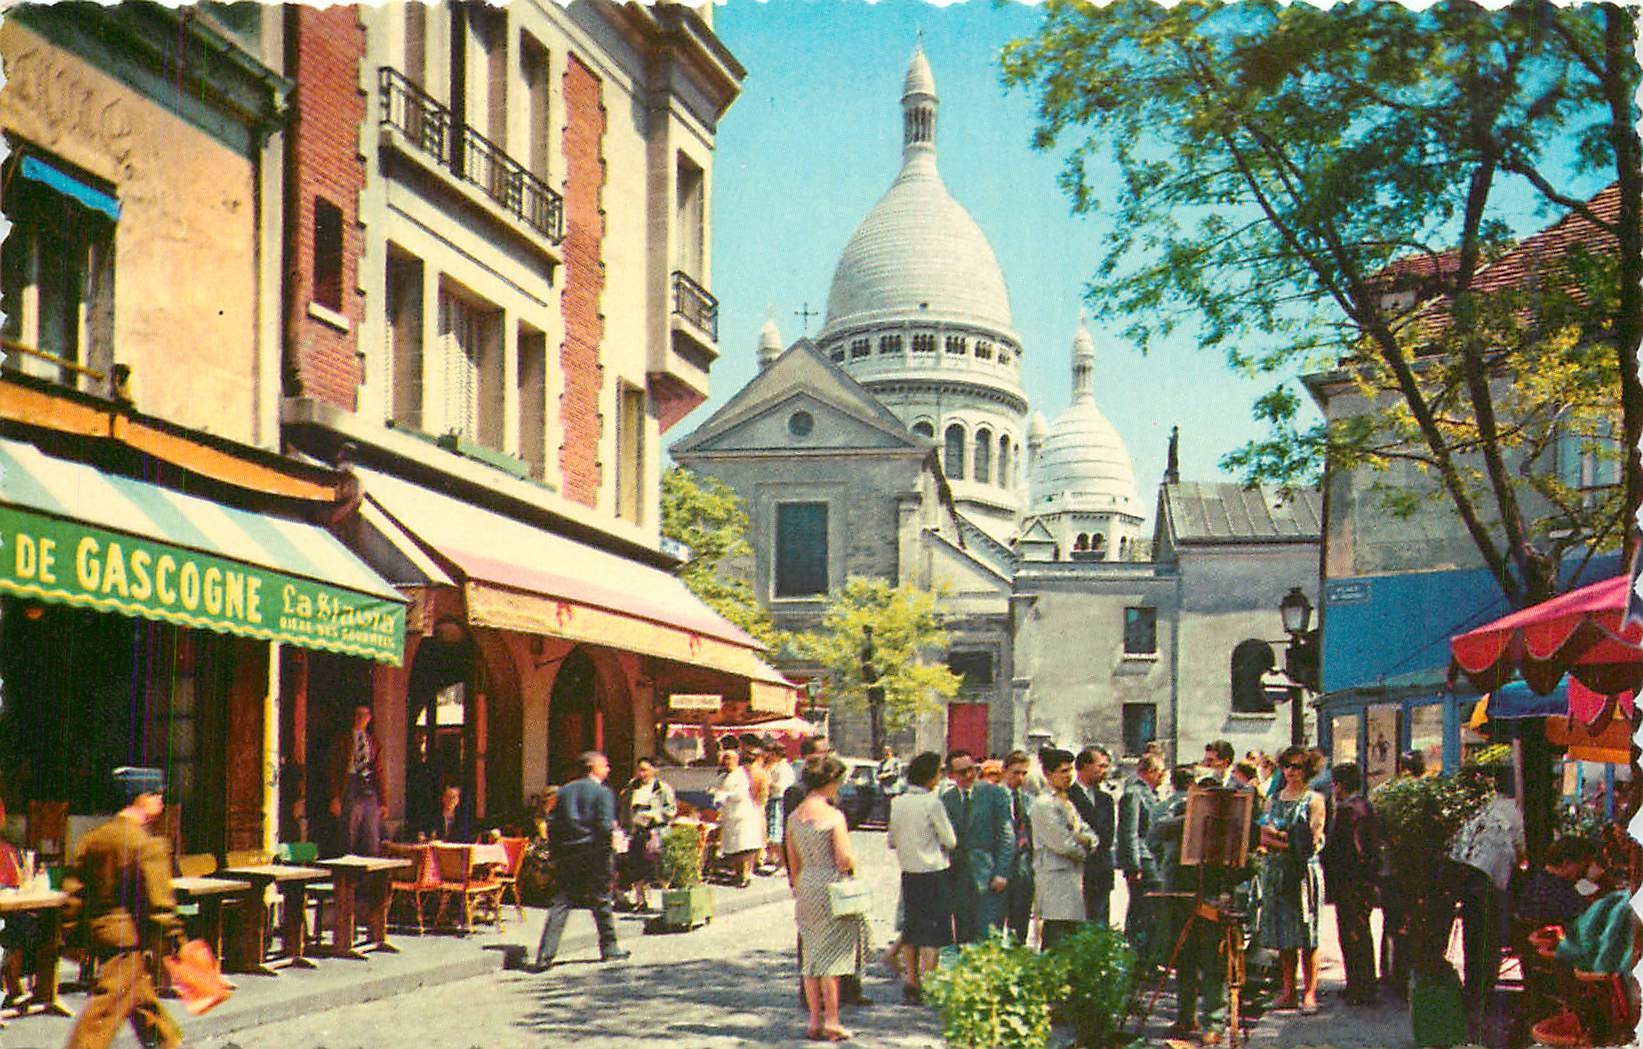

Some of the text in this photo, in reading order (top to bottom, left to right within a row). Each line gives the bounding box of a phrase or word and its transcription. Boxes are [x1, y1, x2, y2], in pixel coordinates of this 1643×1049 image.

[15, 533, 263, 624] DE GASCOGNE
[282, 584, 313, 617] La
